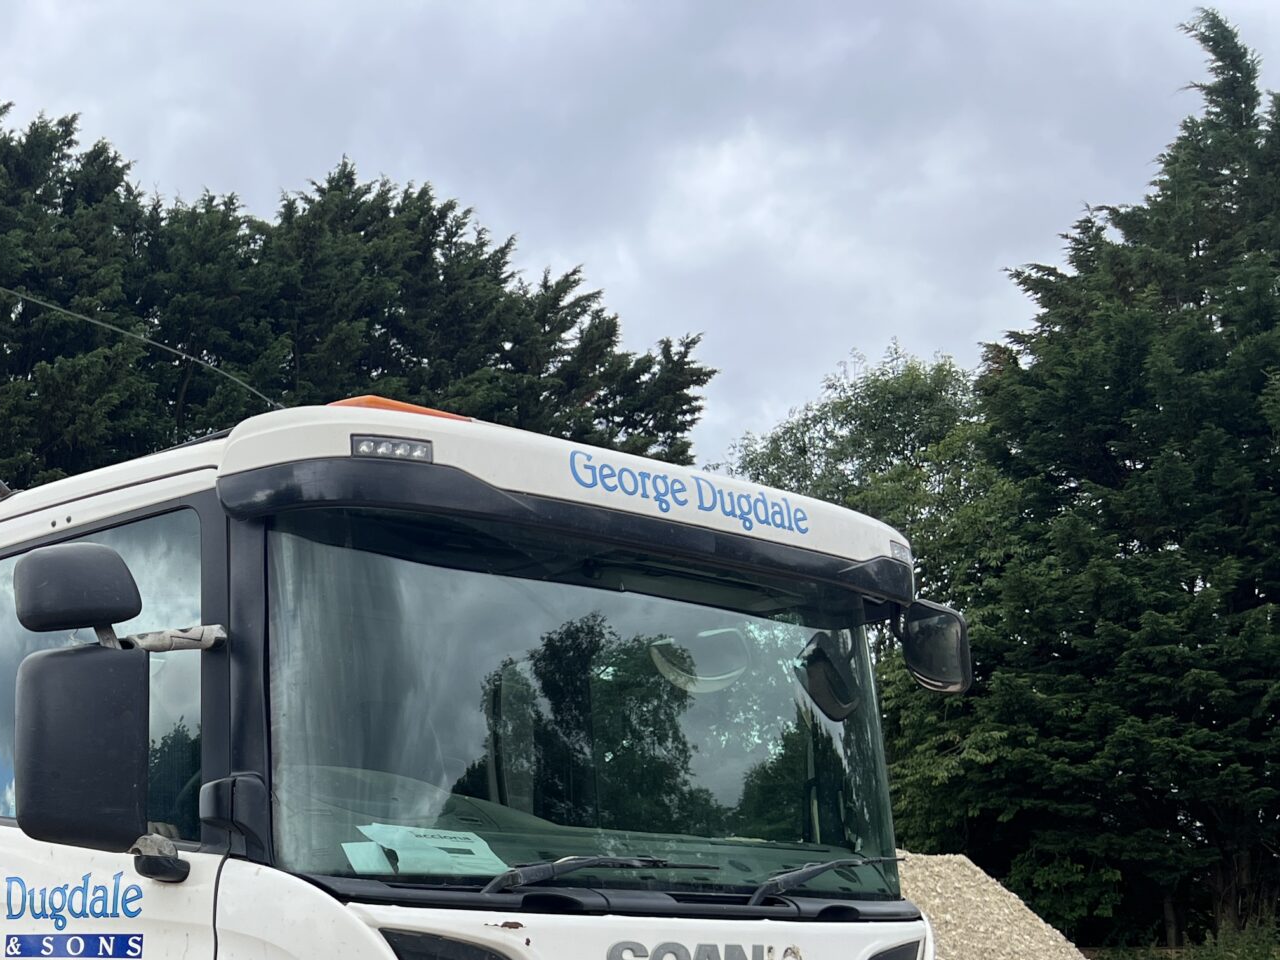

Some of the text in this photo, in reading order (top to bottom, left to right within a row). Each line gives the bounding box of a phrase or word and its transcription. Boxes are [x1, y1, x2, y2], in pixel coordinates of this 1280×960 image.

[569, 449, 809, 534] George Dugdale
[5, 871, 143, 931] Dugdale
[6, 936, 142, 956] & SONS
